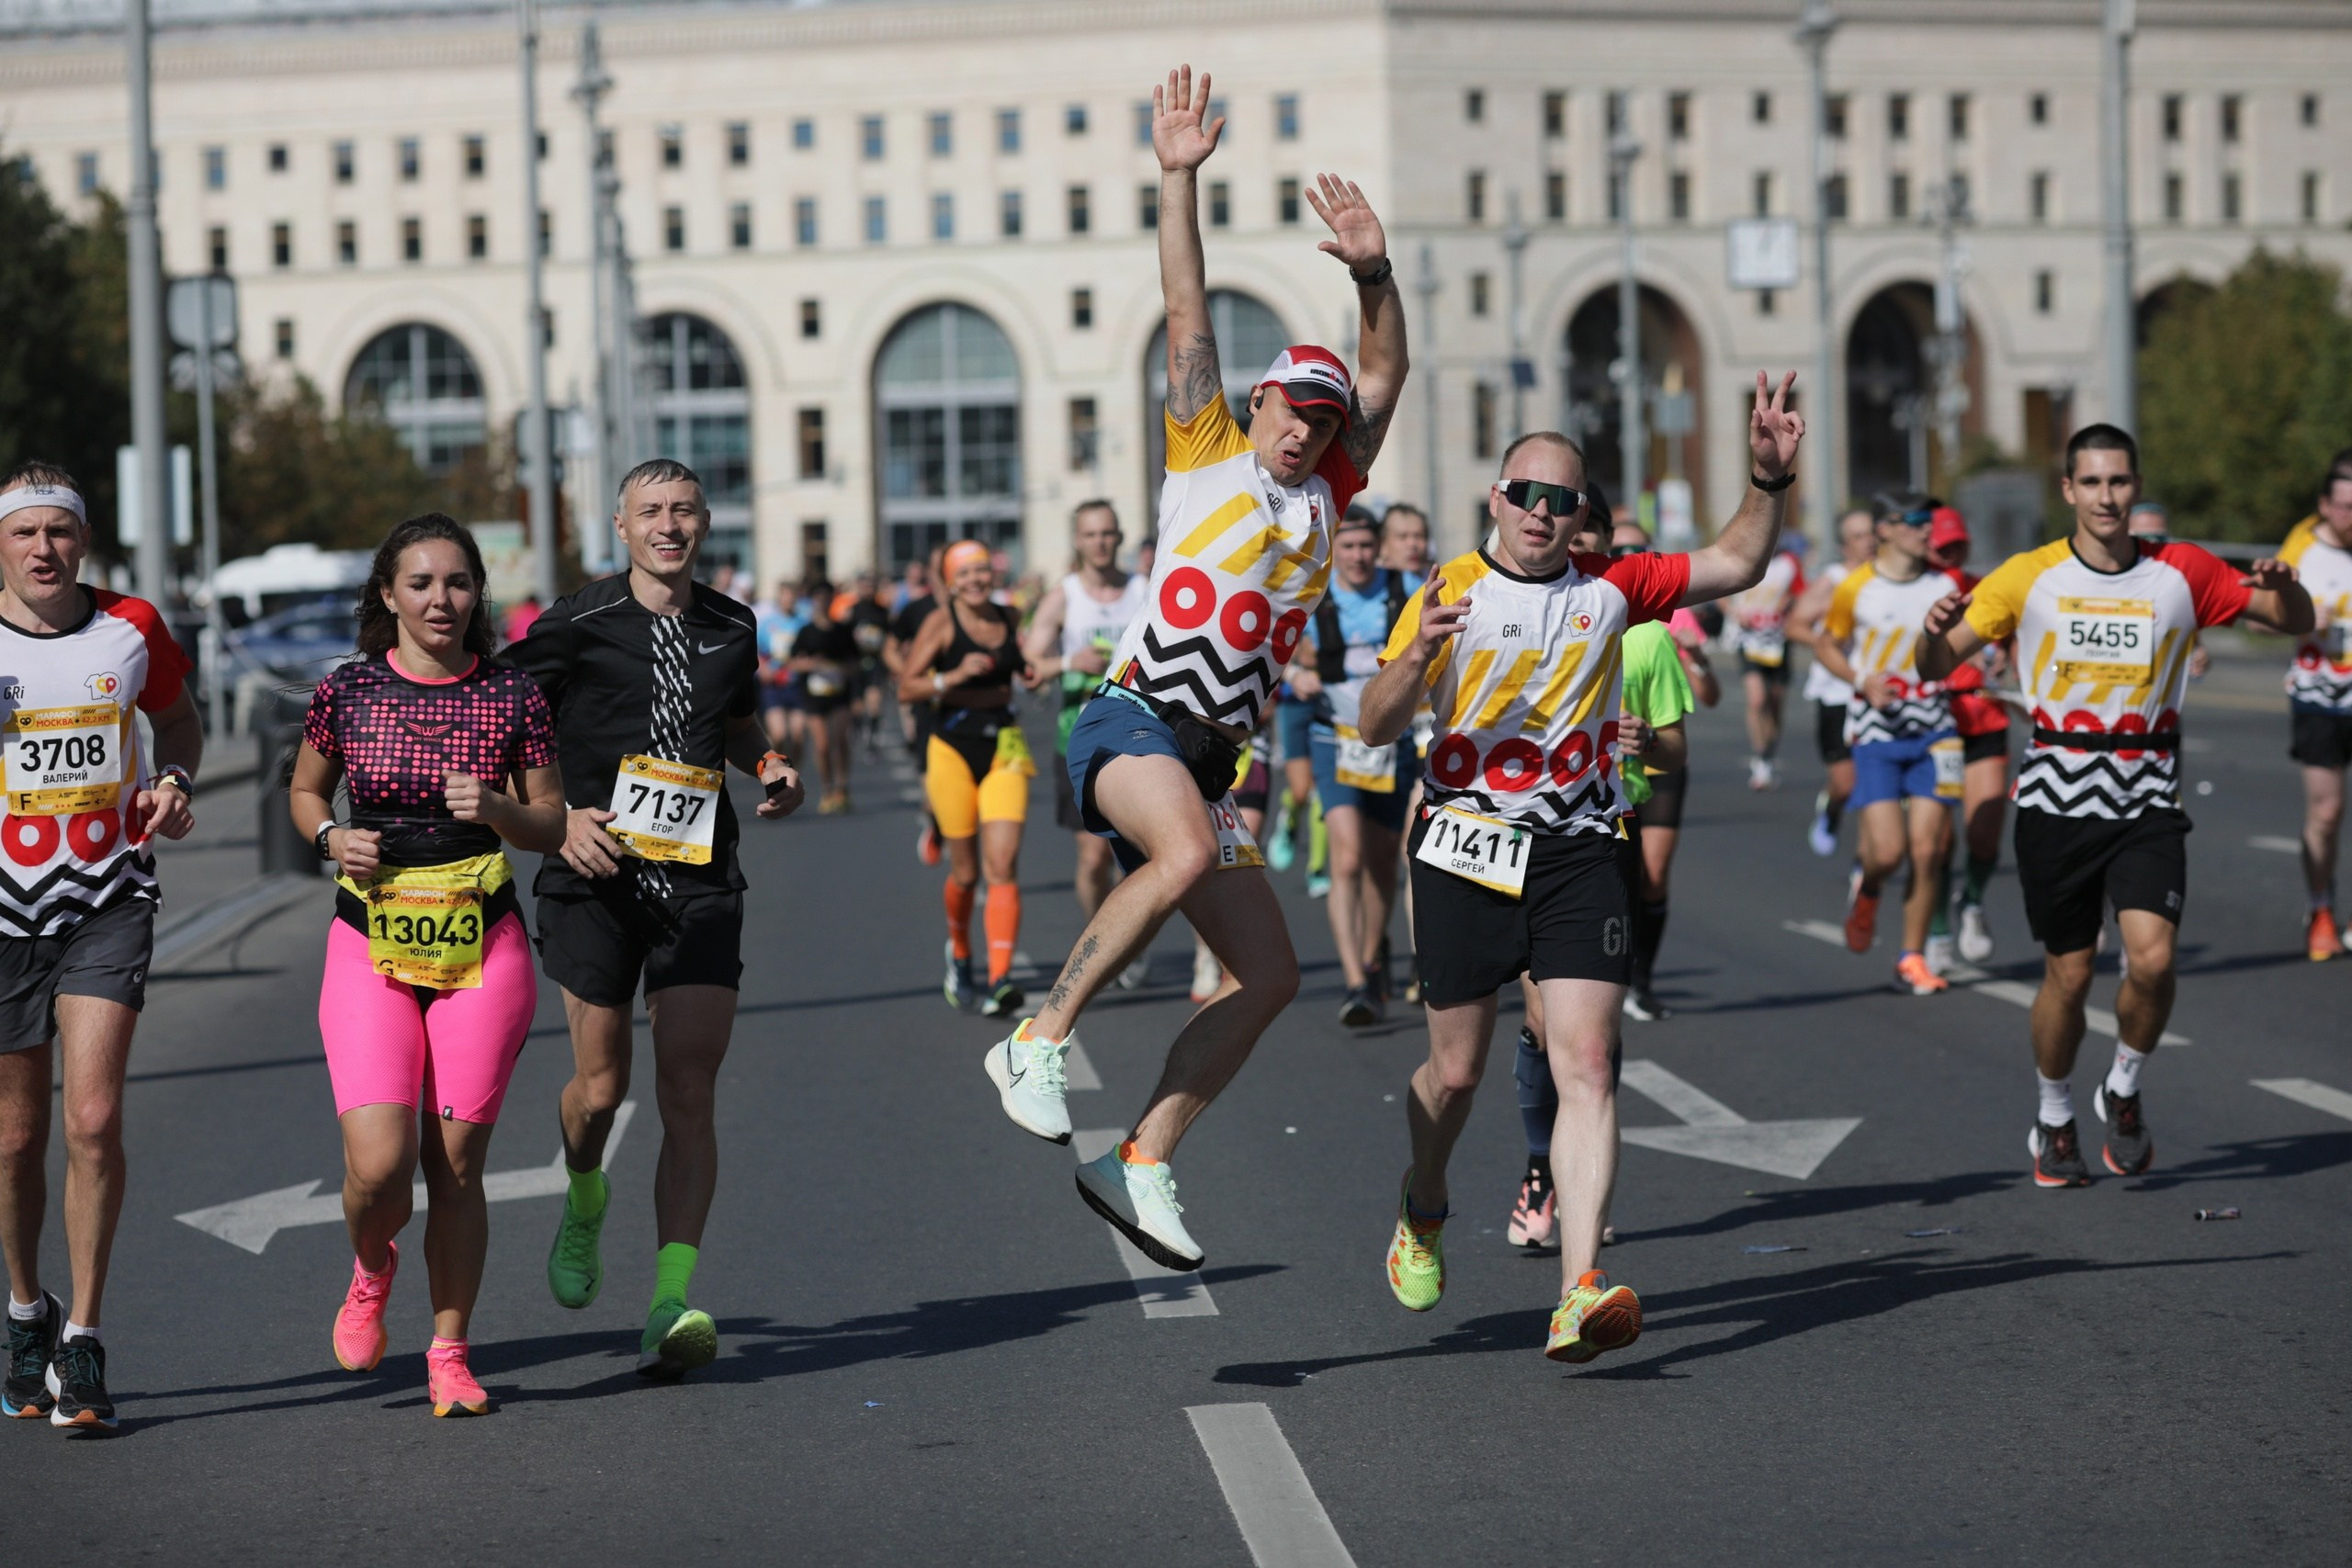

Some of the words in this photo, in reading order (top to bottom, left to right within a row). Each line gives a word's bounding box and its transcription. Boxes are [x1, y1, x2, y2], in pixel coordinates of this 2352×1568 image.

[1502, 624, 1521, 637] GRi
[2070, 621, 2139, 648] 5455
[4, 685, 24, 699] GRi
[36, 710, 80, 720] МАРАФОН
[36, 718, 74, 728] МОСКВА
[20, 734, 106, 772] 3708
[650, 769, 684, 782] МОСКВА
[652, 761, 692, 776] МАРАФОН
[42, 770, 88, 784] ВАЛЕРИЙ
[20, 794, 31, 810] F
[628, 783, 706, 826] 7137
[651, 822, 673, 834] ЕГОР
[1434, 818, 1521, 868] 11411
[1223, 845, 1233, 862] E
[1452, 858, 1485, 874] СЕРГЕЙ
[401, 889, 445, 897] МАРАФОН
[401, 897, 438, 905] МОСКВА
[374, 914, 478, 946] 13043
[410, 948, 442, 958] ЮЛИЯ
